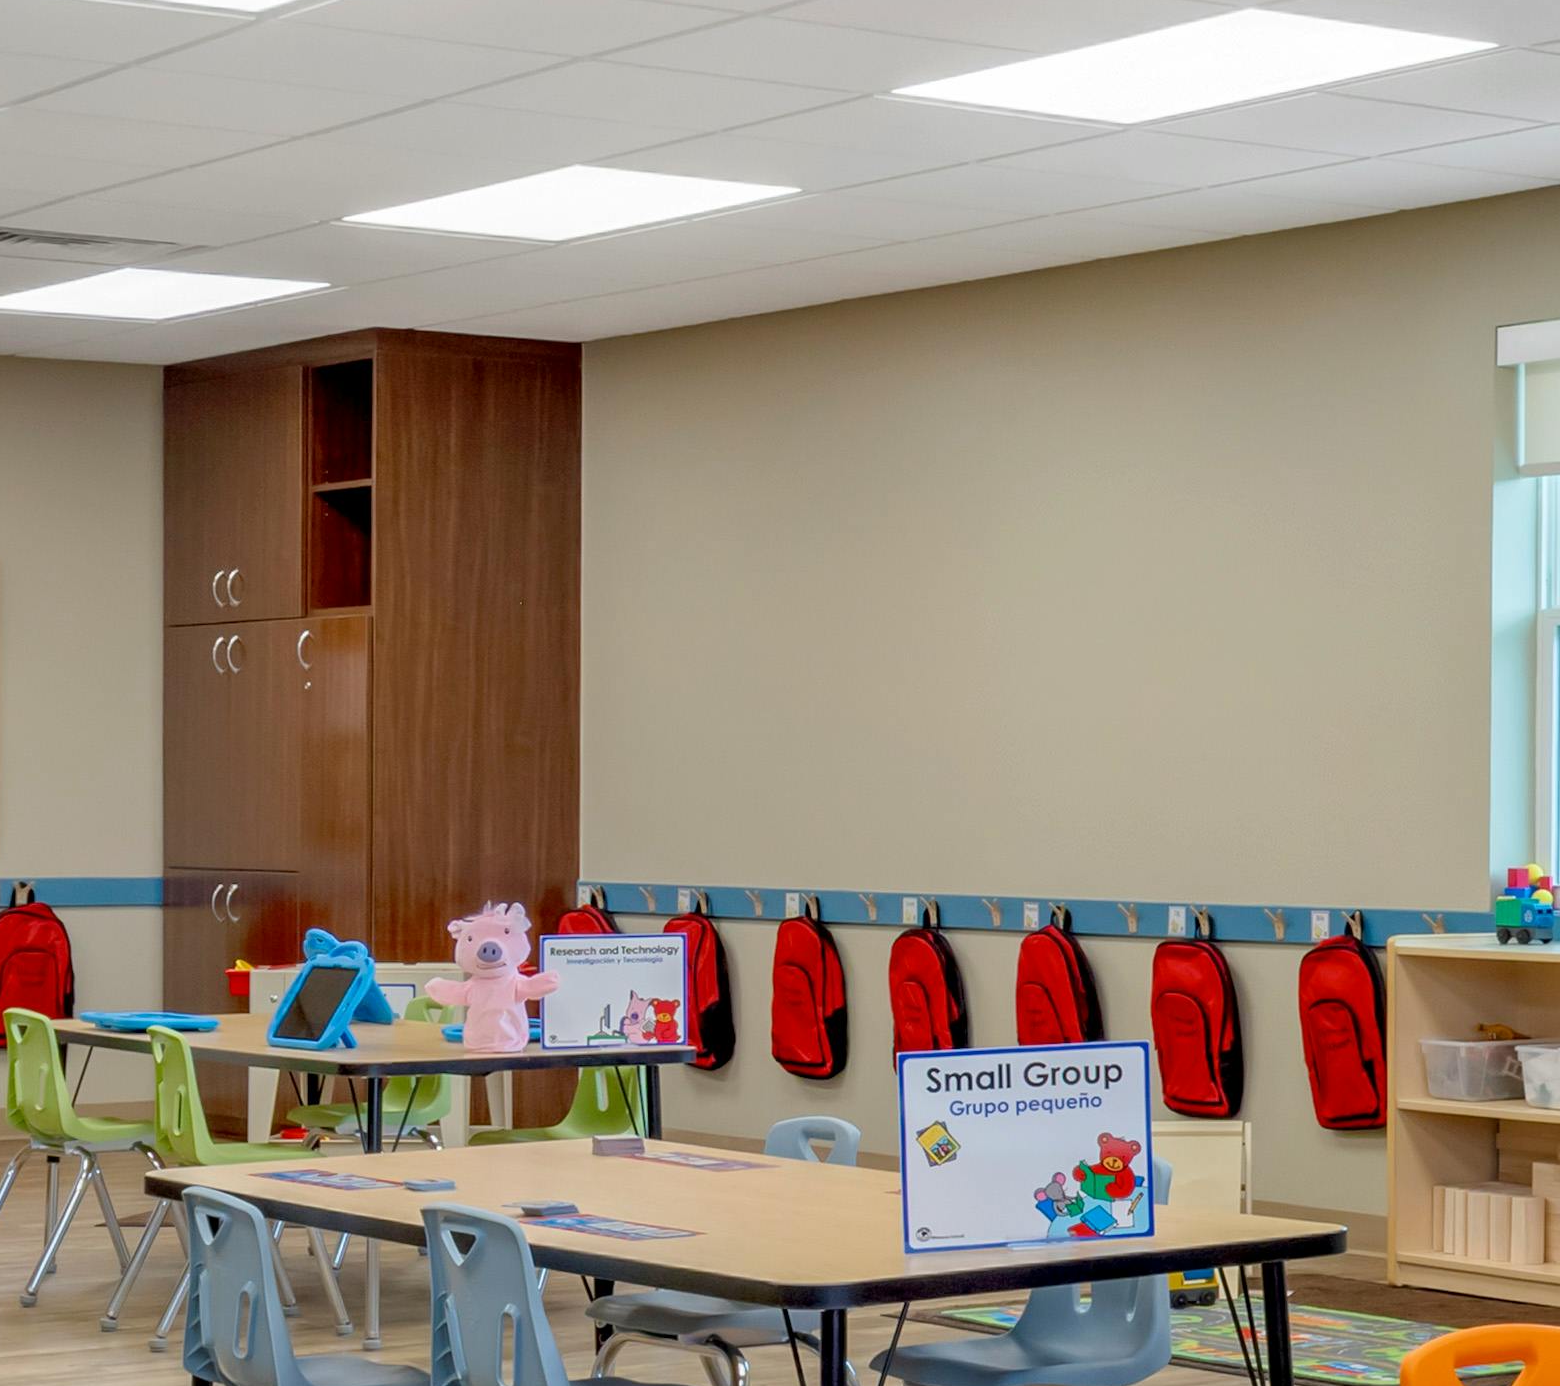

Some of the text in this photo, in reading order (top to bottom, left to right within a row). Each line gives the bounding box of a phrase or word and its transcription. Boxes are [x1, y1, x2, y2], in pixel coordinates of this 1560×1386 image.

[550, 944, 680, 956] Research and Technology
[926, 1061, 1123, 1094] Small Group
[949, 1093, 1103, 1118] Grupo pequeño
